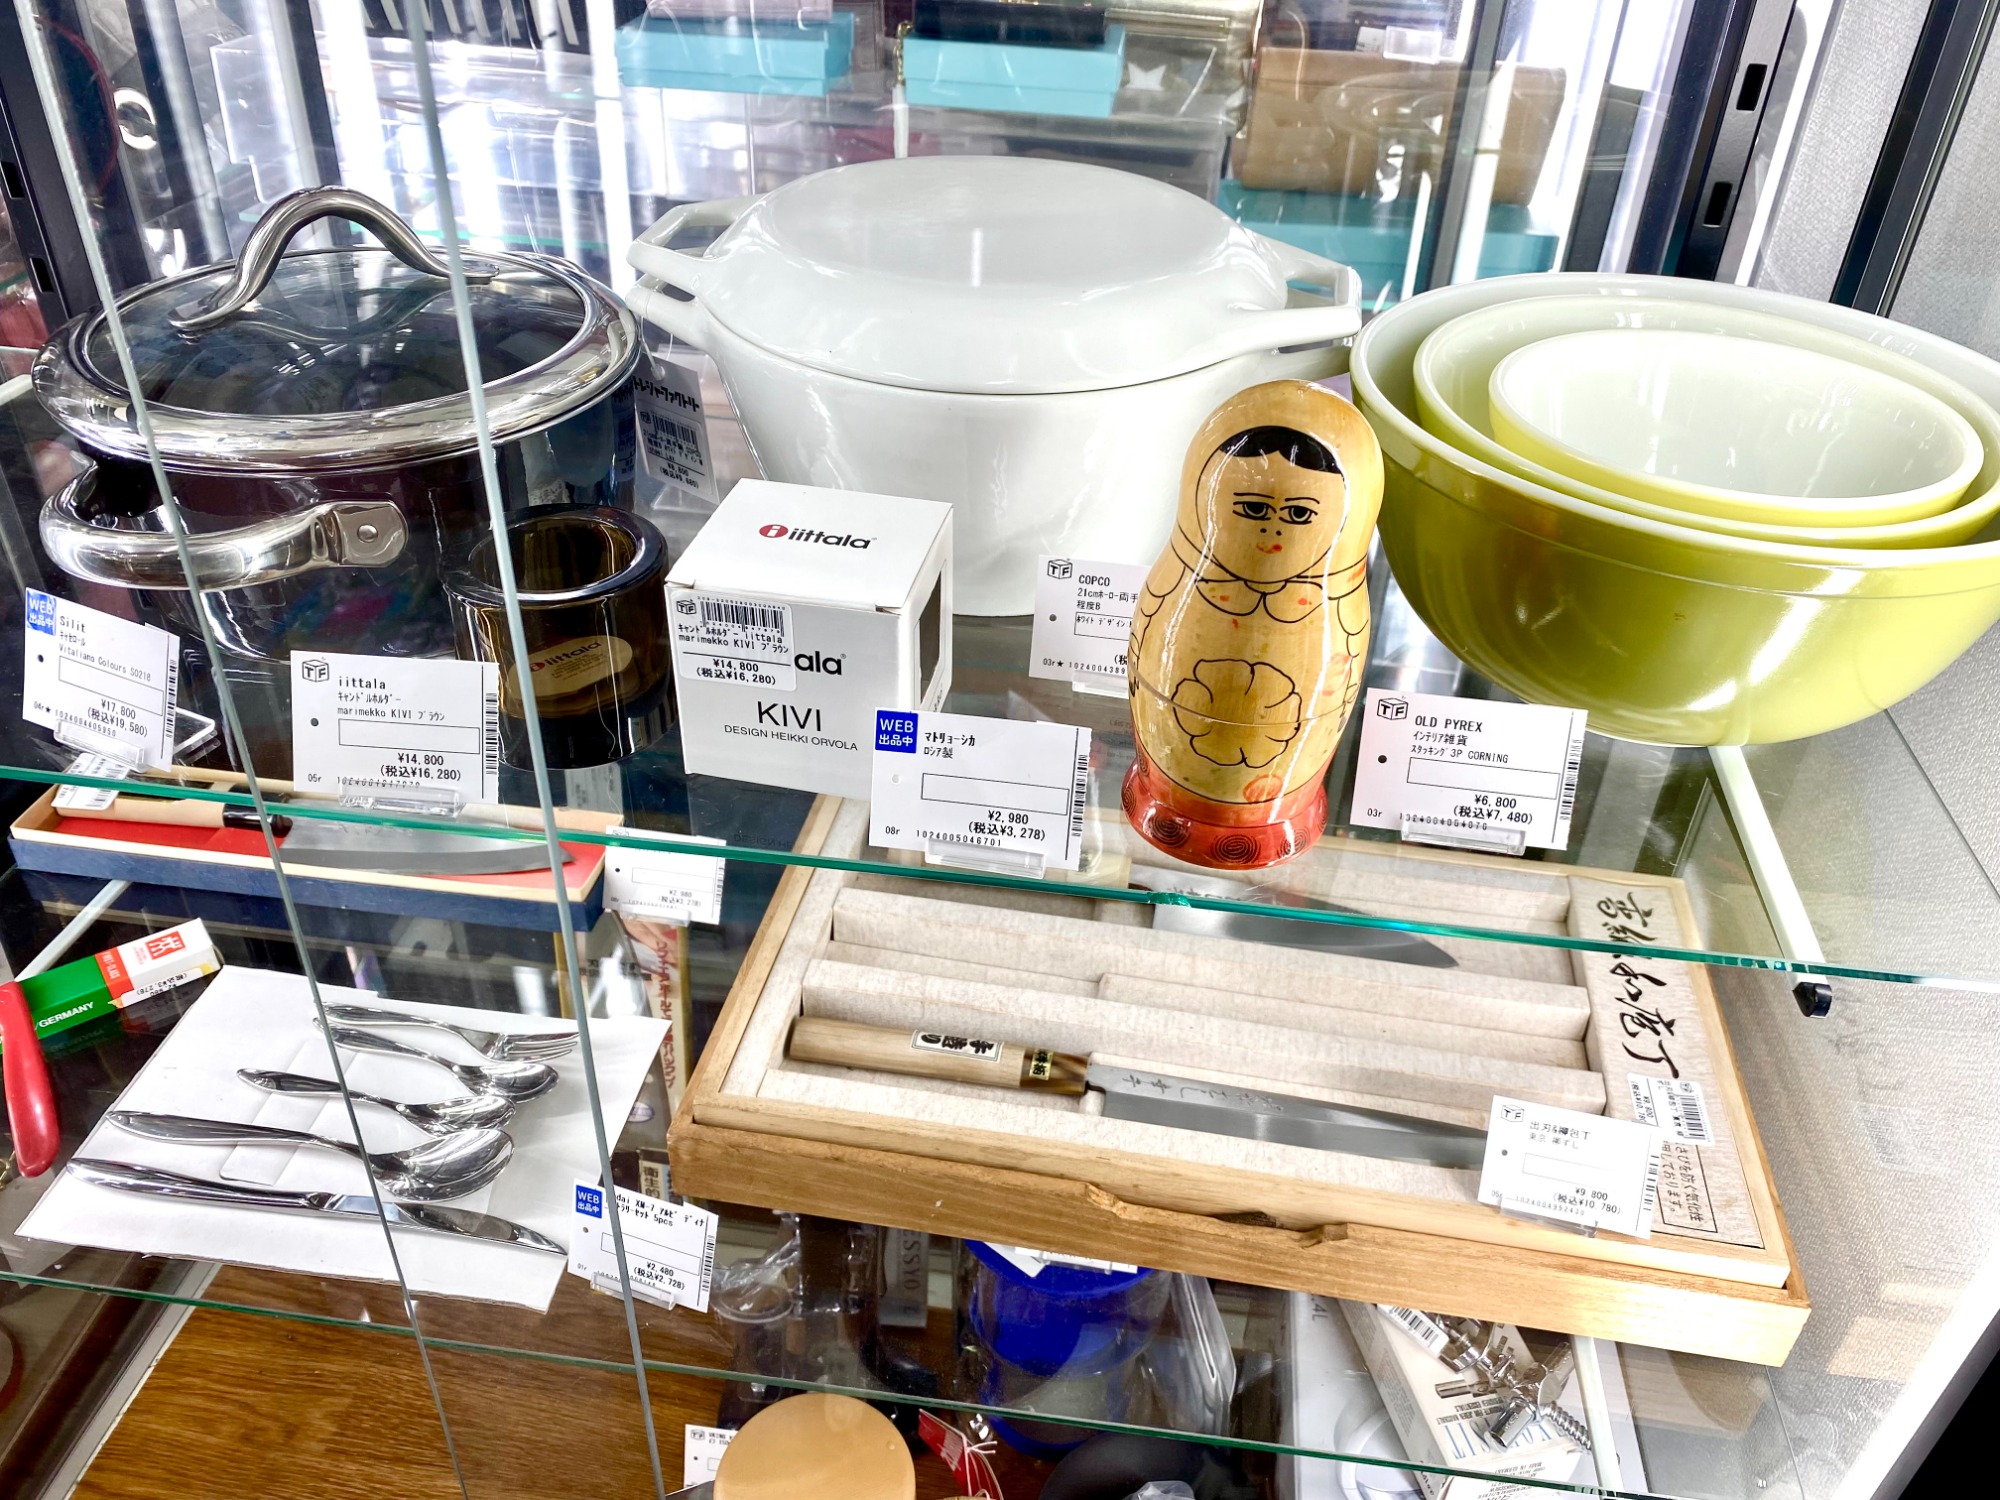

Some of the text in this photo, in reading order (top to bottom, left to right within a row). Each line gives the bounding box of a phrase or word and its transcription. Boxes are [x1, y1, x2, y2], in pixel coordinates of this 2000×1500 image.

[788, 527, 871, 550] iittala
[1078, 574, 1110, 587] COPCO
[29, 597, 54, 615] WEB
[1076, 600, 1101, 610] 程度B
[28, 614, 54, 628] 出品中
[59, 616, 86, 634] Silit
[678, 632, 729, 647] marimekko
[733, 638, 755, 650] KIVI
[745, 628, 783, 645] iittala
[59, 643, 95, 663] Vitaliano
[98, 656, 127, 674] Colours
[712, 658, 759, 674] ¥14,800
[338, 676, 386, 690] iittala
[696, 666, 776, 687] (税込¥16,280)
[101, 698, 136, 720] ¥17,800
[337, 707, 386, 718] marimekko
[391, 710, 412, 719] KIVI
[757, 701, 822, 732] KIVI
[87, 706, 148, 738] (税込¥19,580)
[880, 717, 914, 733] WEB
[1415, 714, 1483, 733] OLD PYREX
[724, 724, 858, 751] DESIGN HEIKKI ORVOLA
[879, 734, 914, 748] 出品中
[924, 731, 976, 747] マトリョーシカ
[1413, 731, 1468, 747] インテリア雑貨
[397, 752, 444, 766] ¥14,800
[924, 746, 953, 759] ロシア製
[1450, 748, 1463, 759] 3P
[1468, 750, 1509, 764] CORNING
[380, 765, 461, 781] (税込¥16,280)
[1474, 794, 1517, 810] ¥6,800
[988, 810, 1029, 825] ¥2,980
[1453, 805, 1533, 825] (税込¥7,480)
[885, 826, 900, 836] 08r
[968, 821, 1045, 841] (税込¥3,278)
[39, 1001, 94, 1028] GERMANY
[1661, 1142, 1682, 1213] 用しております。
[1675, 1143, 1704, 1222] さびを防ぐ気化性
[578, 1190, 600, 1204] WEB
[1575, 1187, 1608, 1201] ¥9,800
[577, 1201, 600, 1213] 出品中
[1553, 1192, 1620, 1215] (税込¥10,780)
[654, 1215, 673, 1227] 5pcs
[646, 1261, 674, 1277] ¥2,480
[633, 1266, 685, 1291] (税込¥2,728)
